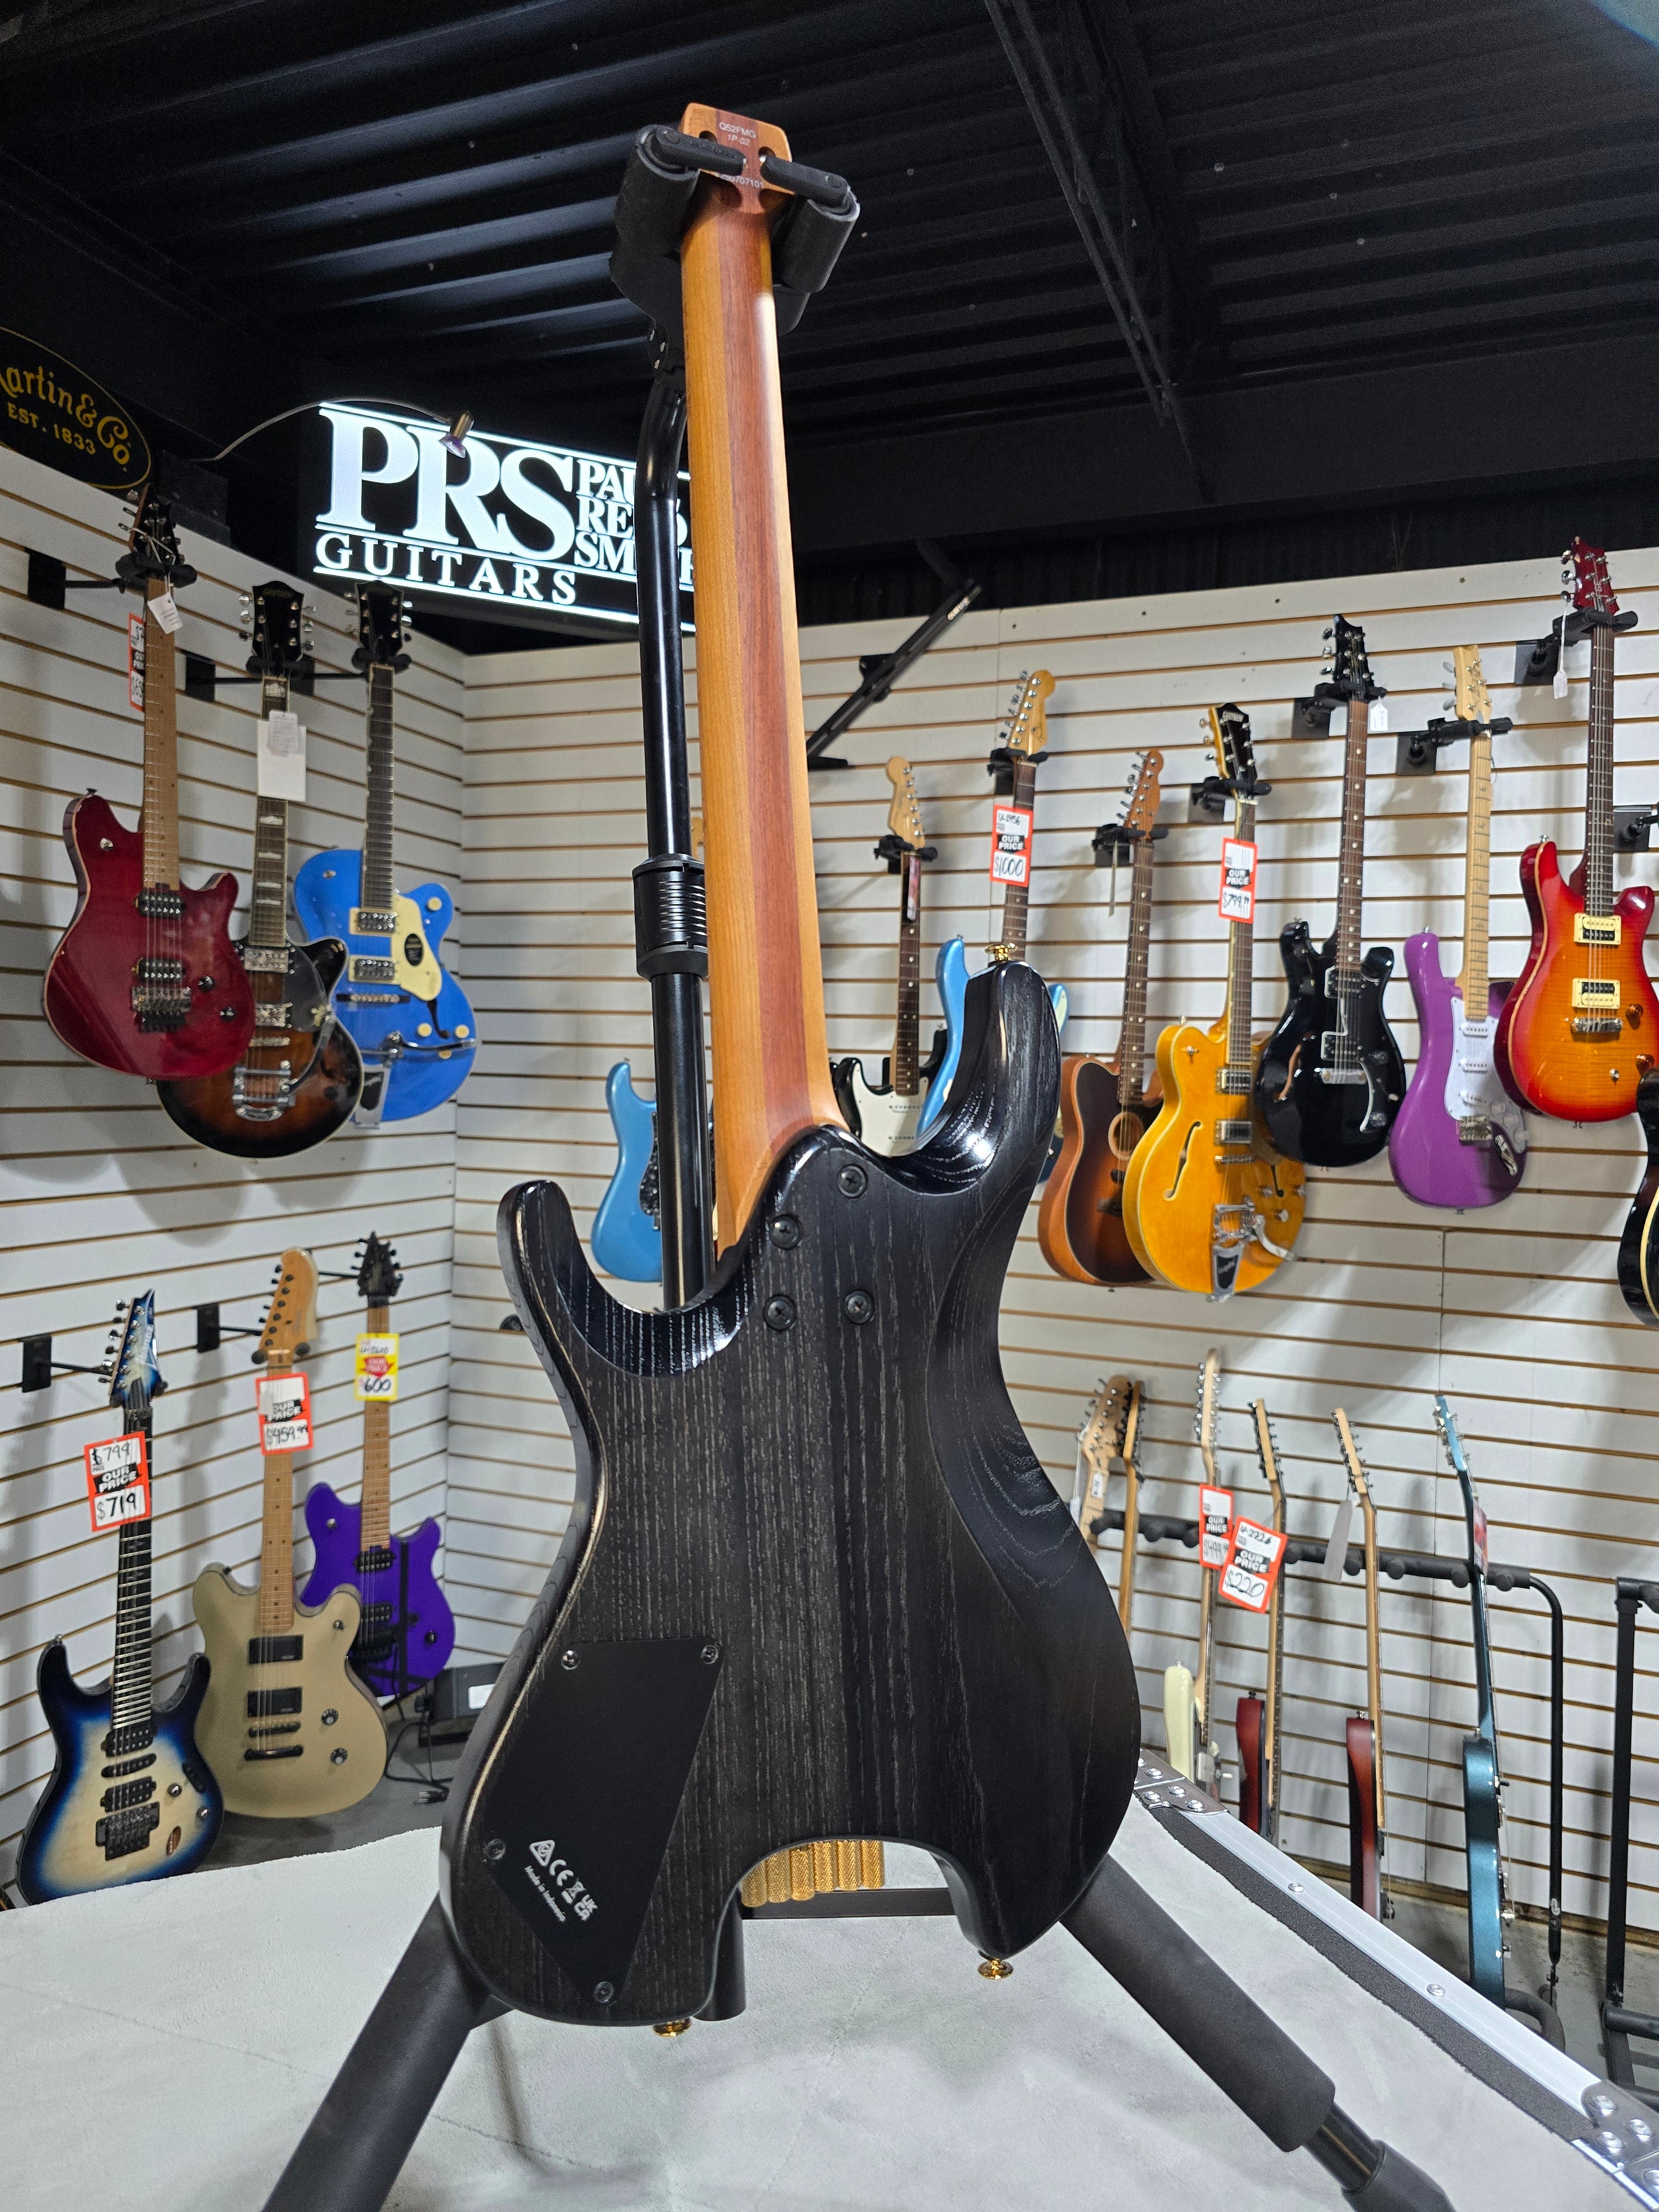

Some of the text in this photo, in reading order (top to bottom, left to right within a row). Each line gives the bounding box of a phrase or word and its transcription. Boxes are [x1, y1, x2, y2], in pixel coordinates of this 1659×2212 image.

[719, 122, 757, 139] Q52FMG
[54, 423, 96, 455] 1833
[315, 408, 575, 561] PRS
[316, 533, 576, 606] GUITARS
[998, 842, 1024, 851] PRICE
[1001, 834, 1020, 843] OUR
[994, 857, 1023, 877] $1000
[1228, 869, 1246, 878] OUR
[1226, 877, 1249, 885] PRICE
[98, 1470, 137, 1493] PRICE
[102, 1465, 130, 1483] OUR
[97, 1493, 137, 1520] $719
[1206, 1523, 1228, 1533] PRICE
[1208, 1516, 1225, 1525] OUR
[1234, 1555, 1268, 1574] PRICE
[1240, 1550, 1264, 1564] OUR
[1224, 1569, 1265, 1597] $220
[524, 1865, 541, 1886] Made
[542, 1890, 566, 1923] Indonesia
